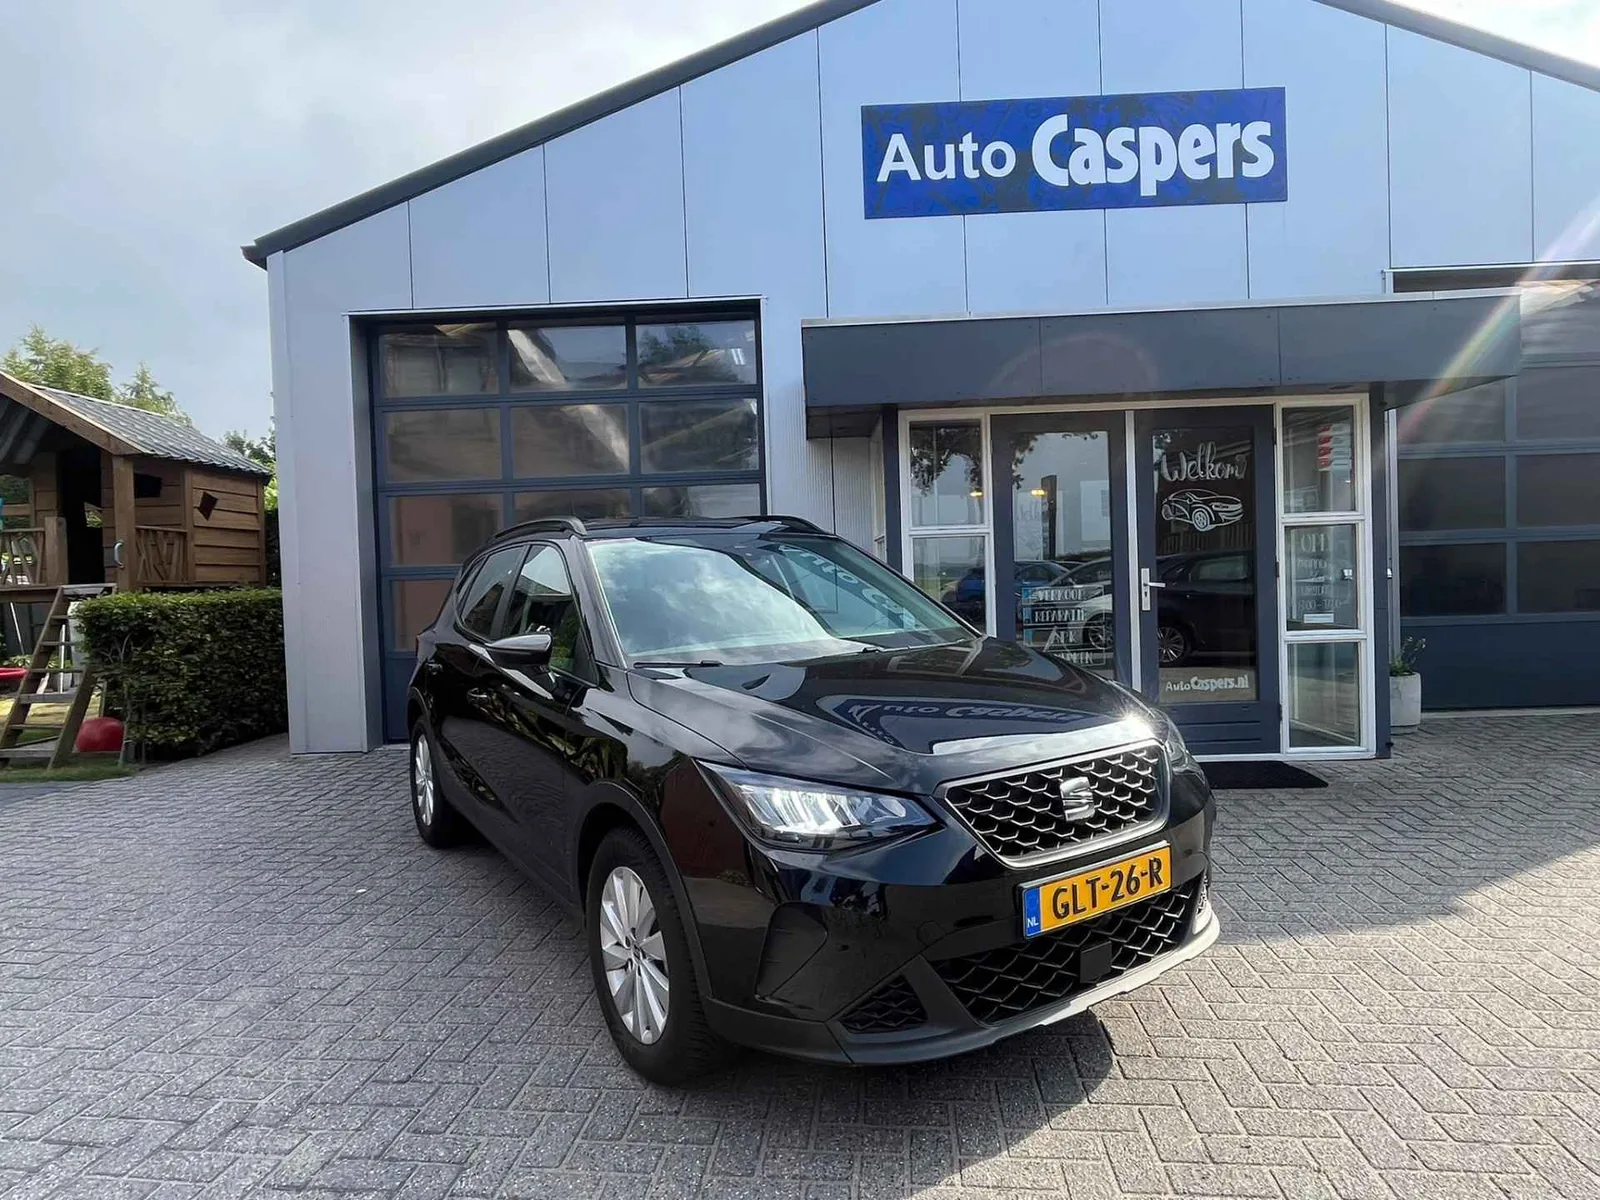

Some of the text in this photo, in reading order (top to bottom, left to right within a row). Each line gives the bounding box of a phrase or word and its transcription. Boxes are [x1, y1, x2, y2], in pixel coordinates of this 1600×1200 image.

[876, 114, 1275, 197] Auto Caspers
[1161, 441, 1248, 482] Welkom
[1038, 588, 1086, 601] VERKOOP
[1052, 856, 1163, 920] GLT-26-R
[1027, 917, 1039, 928] NL
